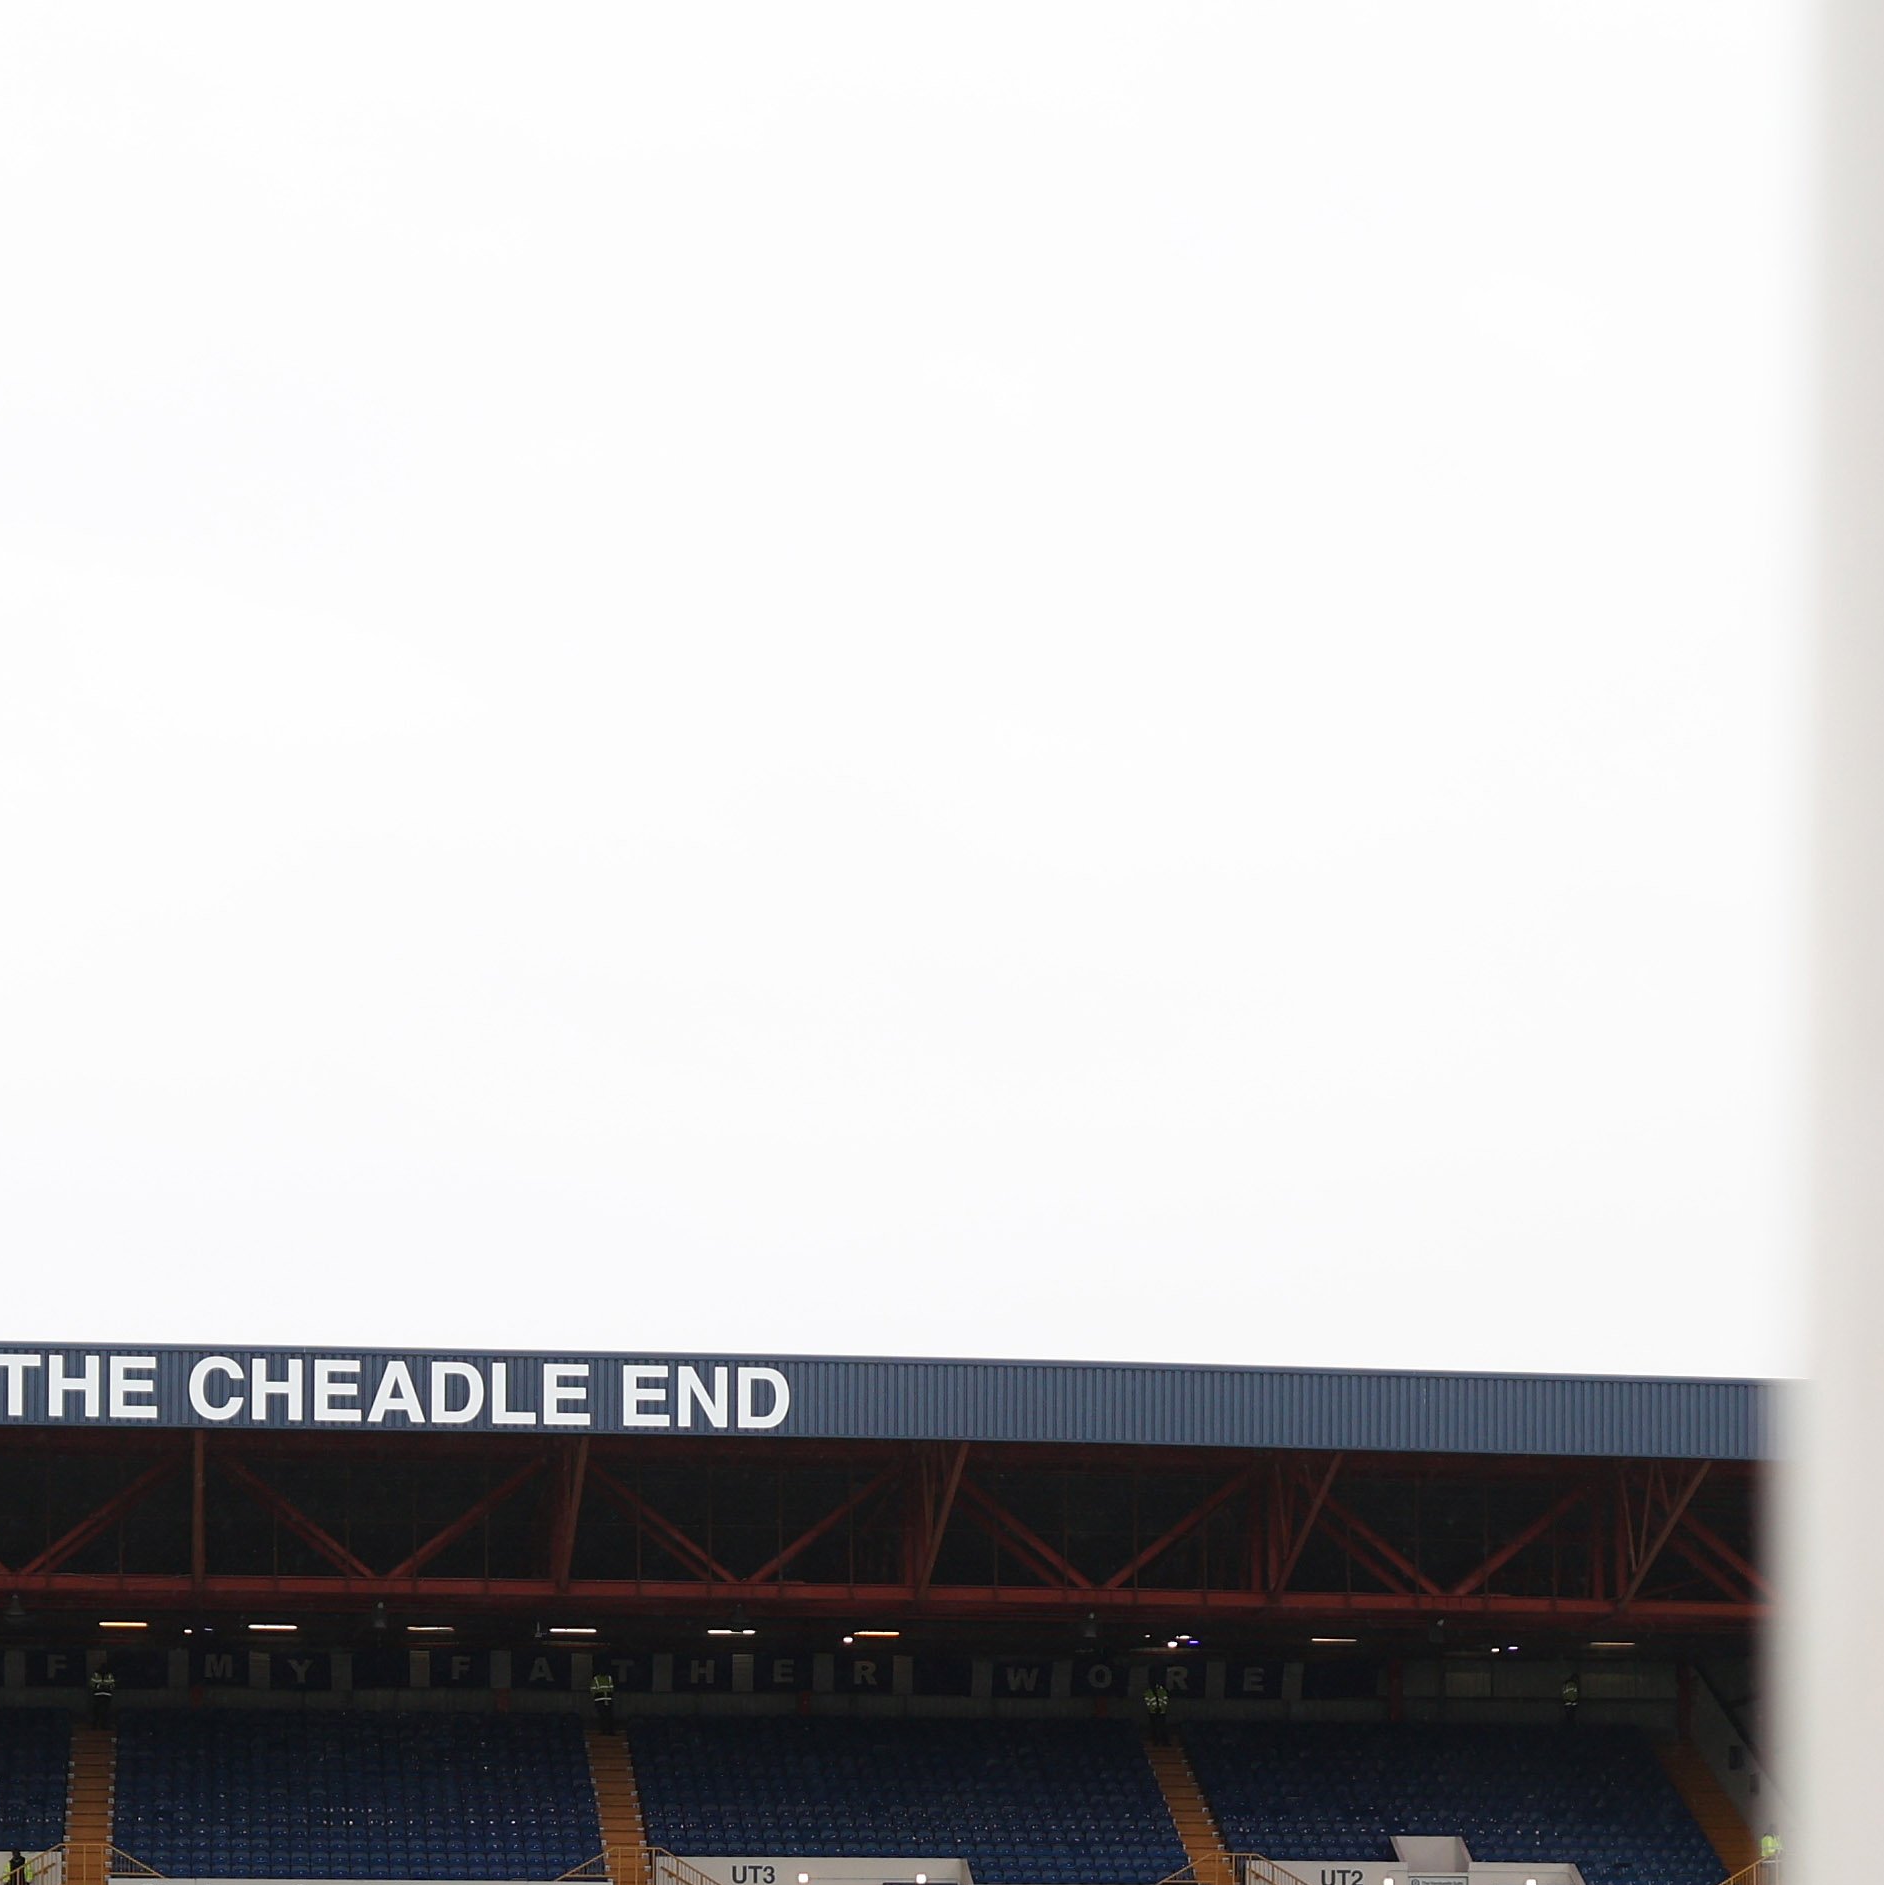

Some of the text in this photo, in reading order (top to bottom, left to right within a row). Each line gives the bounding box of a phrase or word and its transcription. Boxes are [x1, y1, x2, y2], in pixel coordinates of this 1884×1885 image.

[188, 1354, 592, 1425] CHEADLE
[623, 1364, 790, 1429] END
[731, 1865, 776, 1884] UT3
